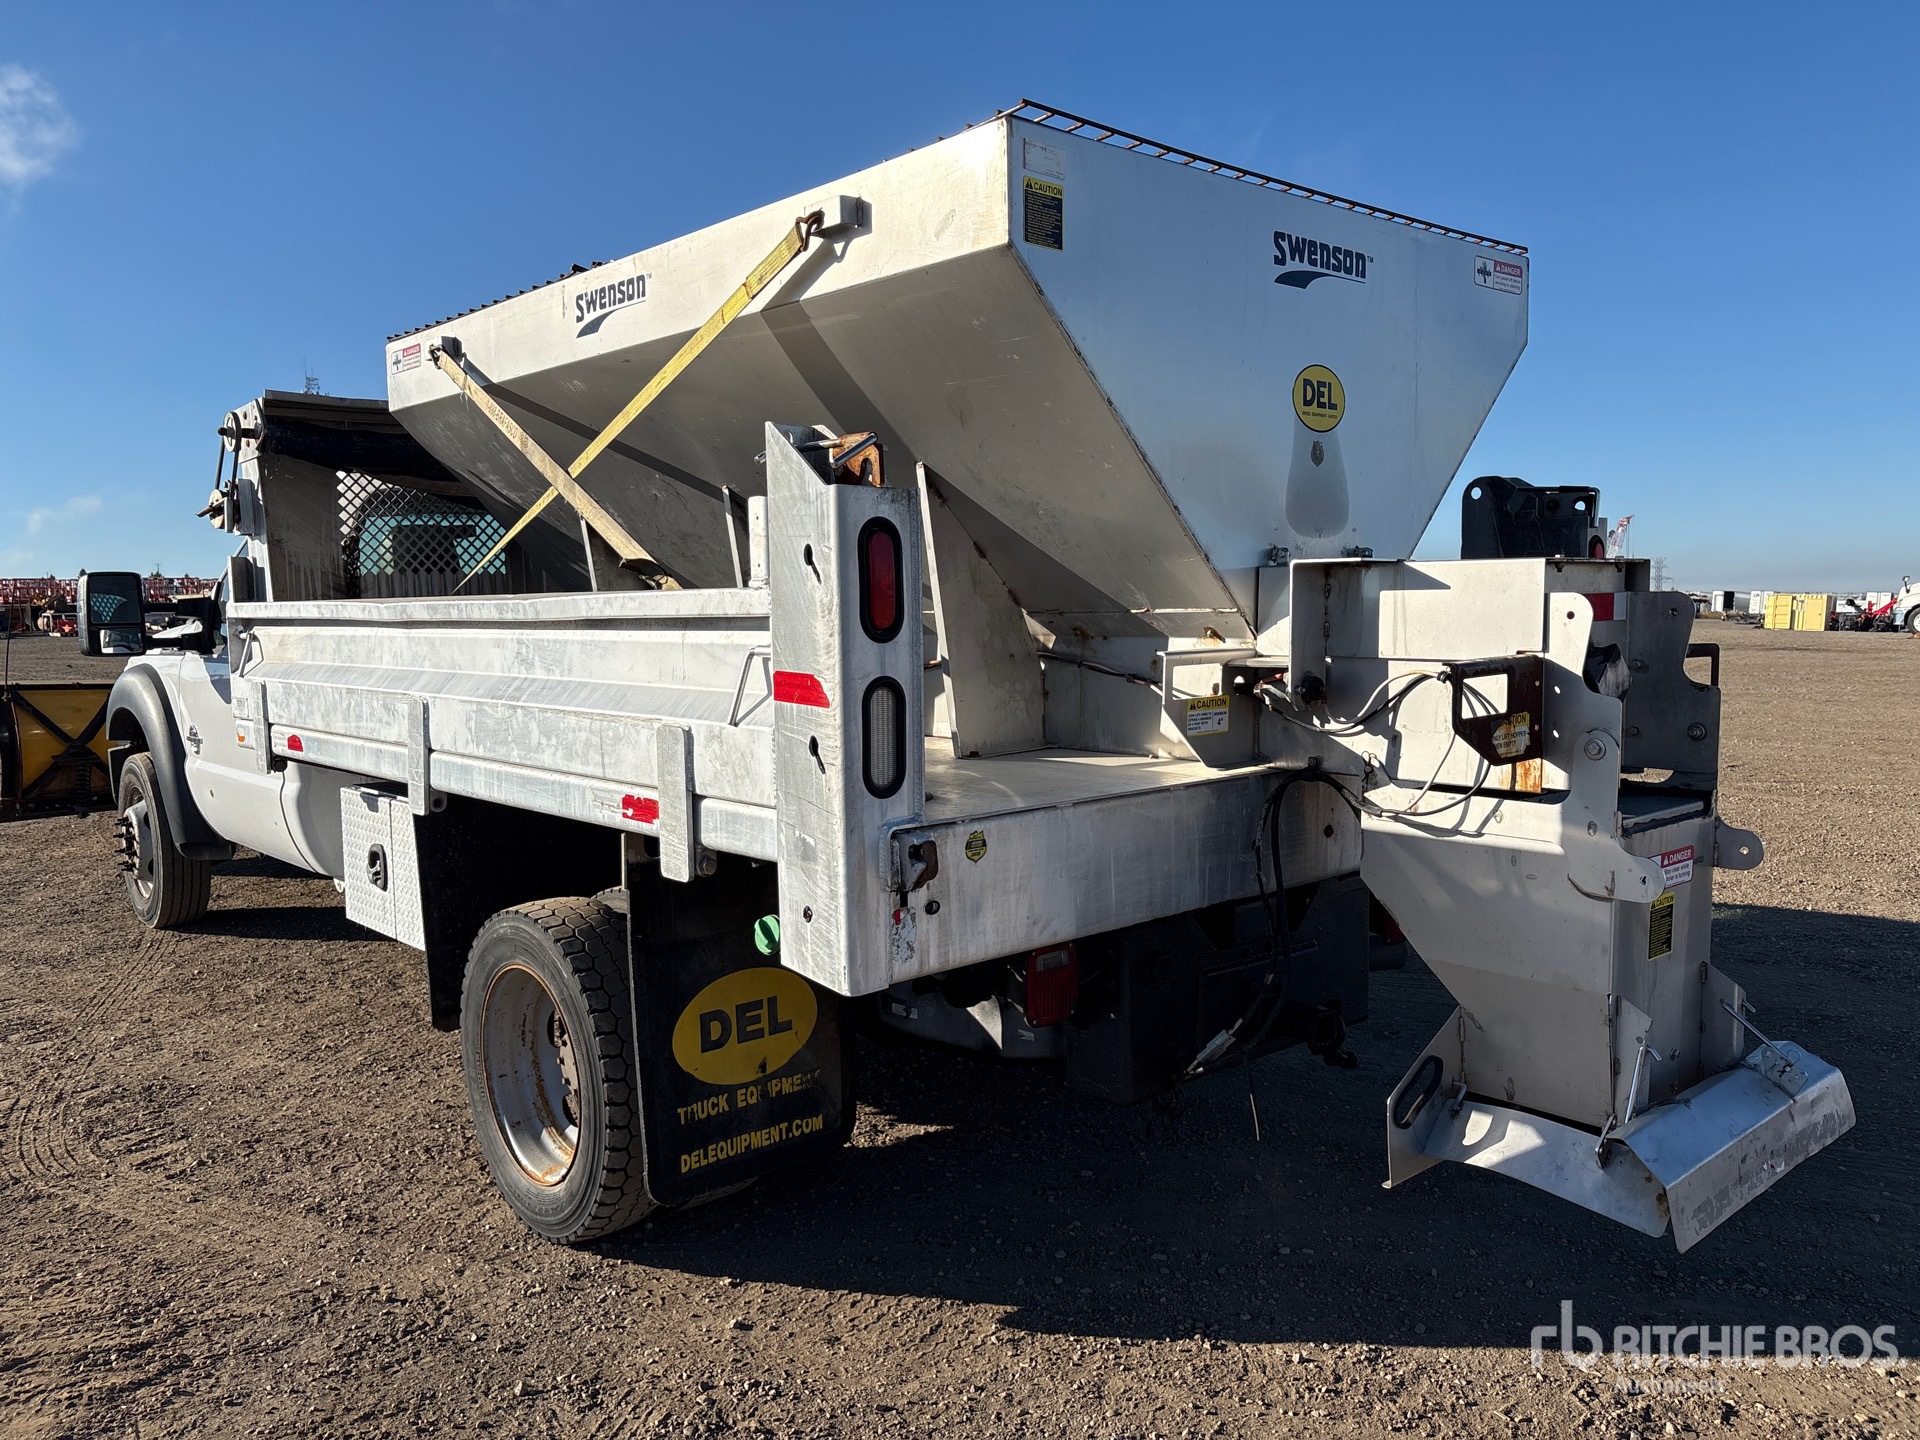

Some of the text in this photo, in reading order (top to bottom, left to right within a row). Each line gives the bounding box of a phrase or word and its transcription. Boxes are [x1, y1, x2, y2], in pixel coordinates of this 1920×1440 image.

[1033, 181, 1063, 197] CAUTION
[1500, 264, 1521, 276] DANGER
[1302, 377, 1338, 411] DEL
[1196, 697, 1227, 709] CAUTION
[1510, 730, 1527, 739] HOPPER
[1669, 849, 1692, 864] DANGER
[1672, 865, 1681, 873] clear
[1681, 863, 1690, 871] while
[1679, 870, 1691, 879] turning
[1656, 894, 1674, 907] CAUTION
[699, 995, 794, 1055] DEL
[677, 1092, 730, 1126] TRUCK
[680, 1112, 824, 1175] DELEQUIPMENT.COM
